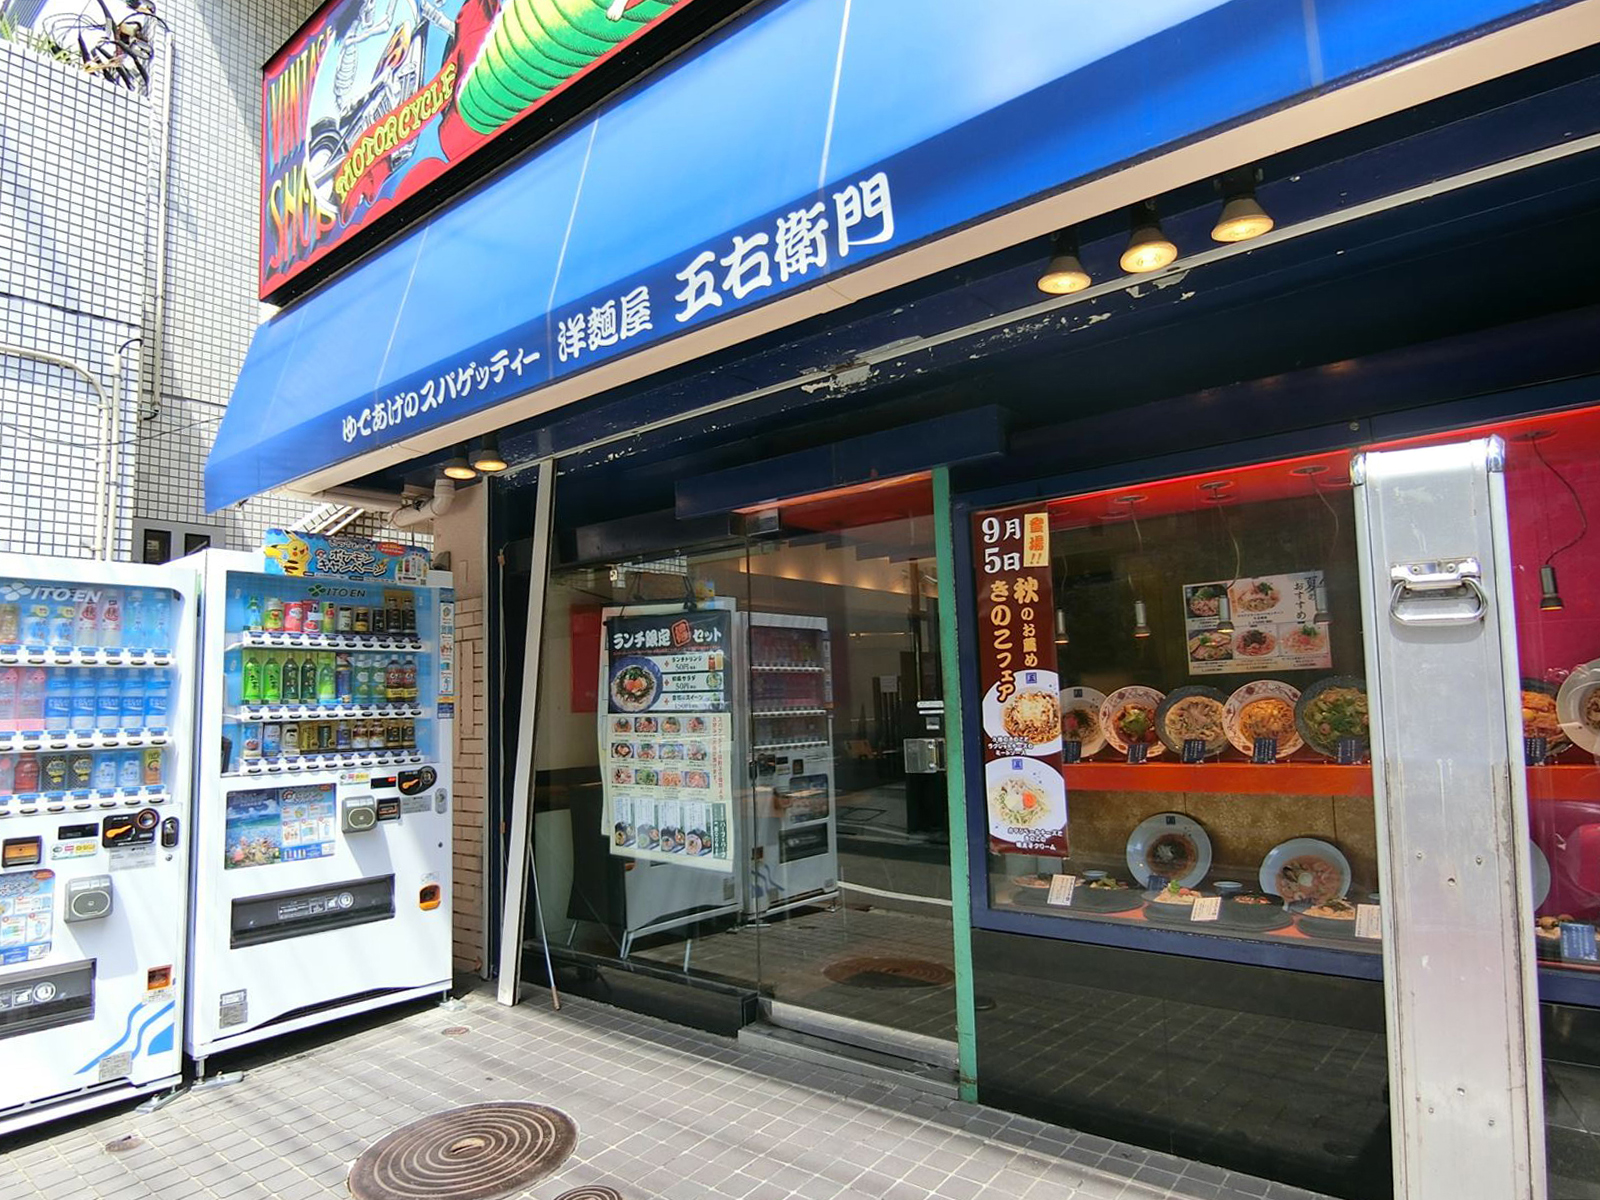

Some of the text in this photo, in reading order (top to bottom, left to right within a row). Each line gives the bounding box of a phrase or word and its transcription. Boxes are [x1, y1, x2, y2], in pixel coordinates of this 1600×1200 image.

[334, 64, 457, 204] MOTORCYCLE
[342, 348, 540, 444] ゆであげのスパゲッティー
[674, 171, 894, 322] 五右衛門
[982, 517, 1021, 544] 9月
[317, 558, 386, 577] キャンペーン
[329, 548, 375, 564] ポケモン
[983, 547, 1021, 574] 5日
[31, 586, 102, 603] ITO EN
[326, 587, 366, 598] ITO EN
[990, 579, 1016, 703] きのこフェア
